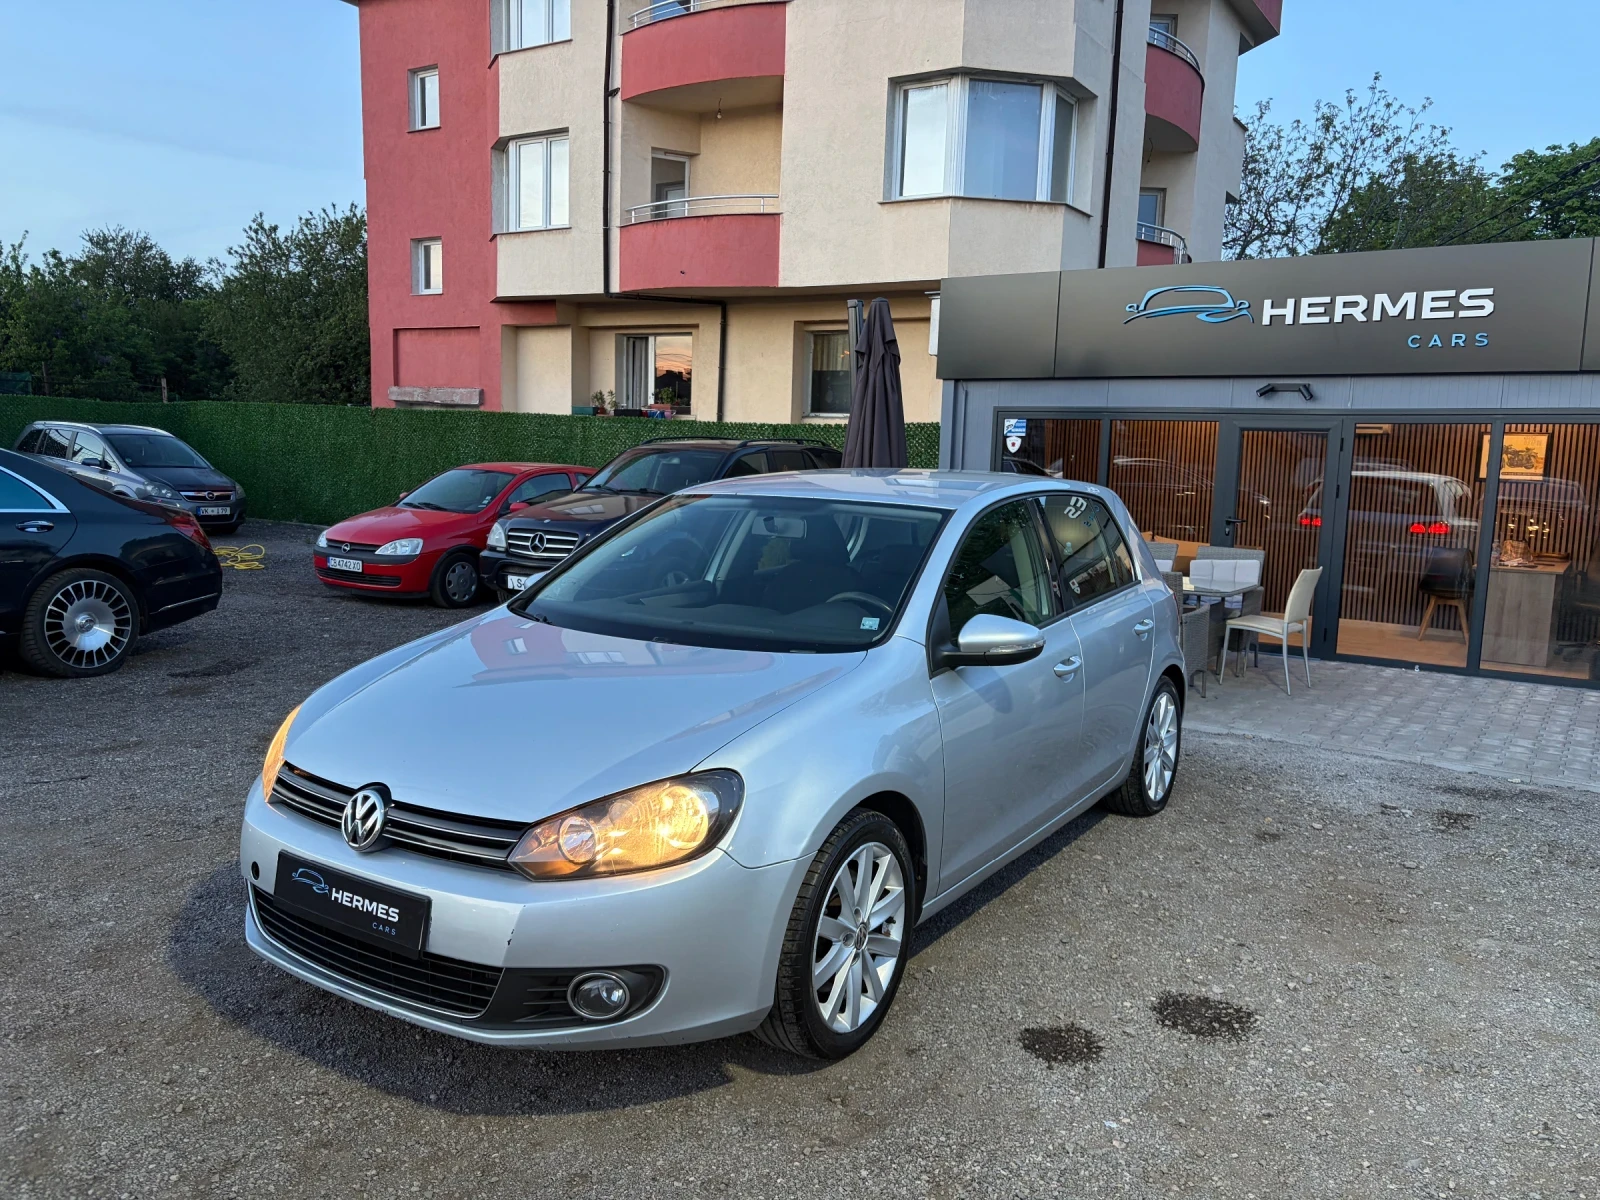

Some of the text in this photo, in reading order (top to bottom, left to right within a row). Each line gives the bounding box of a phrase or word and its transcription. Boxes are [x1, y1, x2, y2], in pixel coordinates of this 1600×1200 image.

[1262, 288, 1495, 326] HERMES
[1407, 332, 1489, 348] CARS
[331, 887, 399, 922] HERMES
[372, 922, 396, 935] CARS
